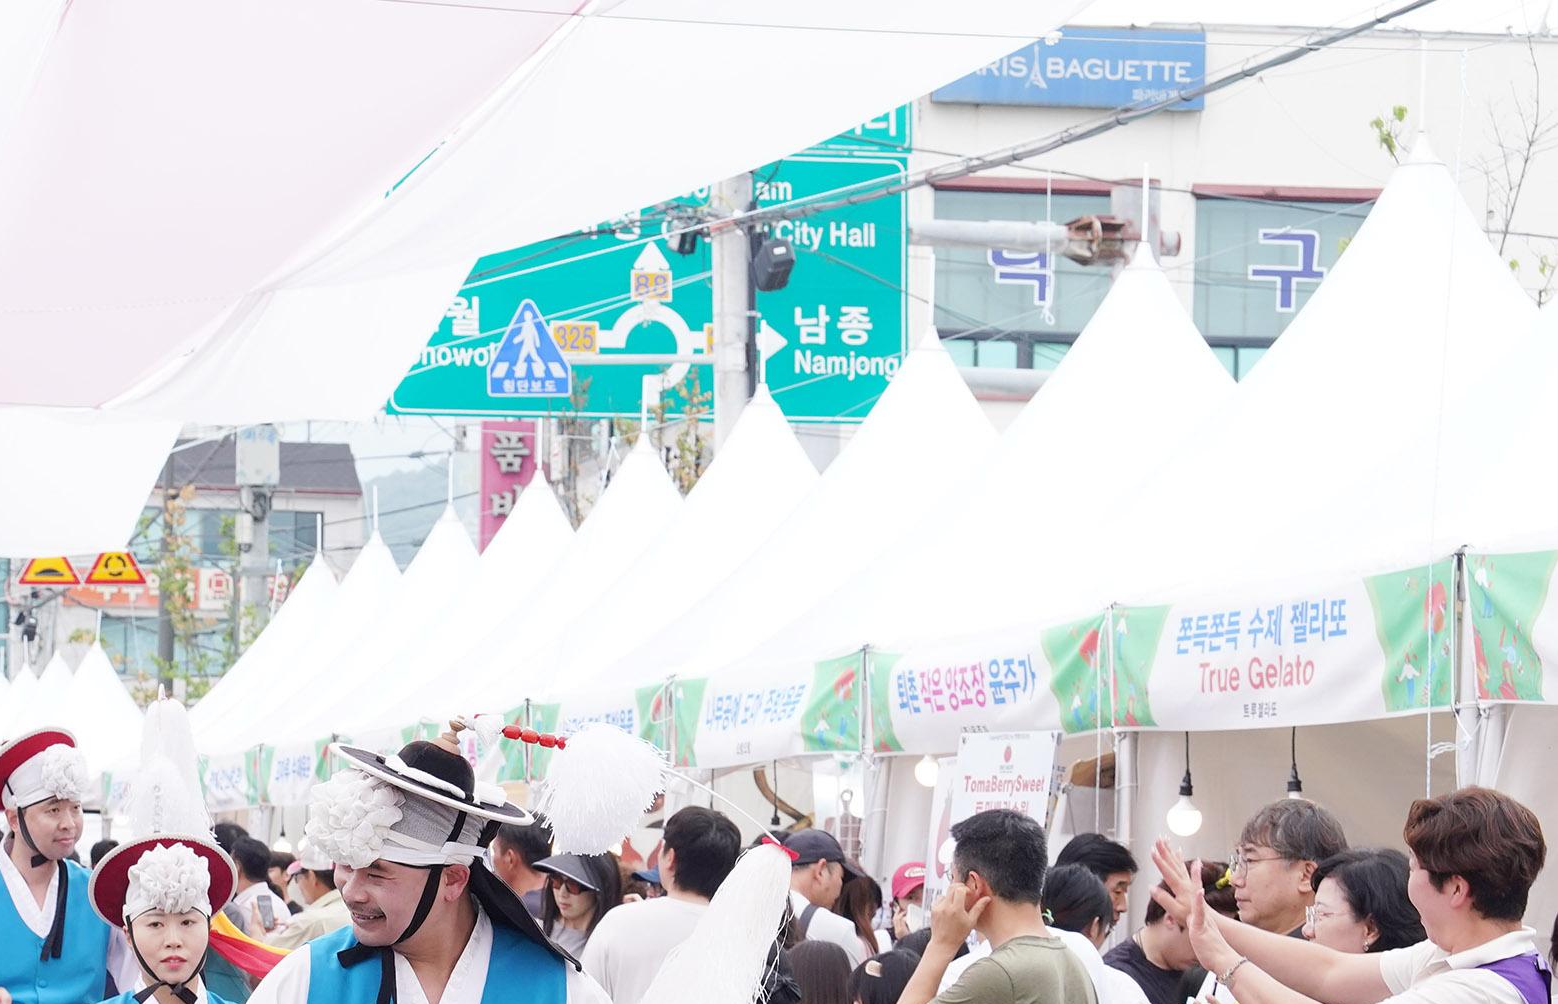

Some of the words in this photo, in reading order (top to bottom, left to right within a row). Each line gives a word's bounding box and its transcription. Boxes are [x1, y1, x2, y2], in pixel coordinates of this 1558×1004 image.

[1046, 57, 1192, 83] BAGUETTE
[775, 219, 824, 252] City
[829, 221, 876, 247] Hall
[635, 274, 668, 297] 88
[556, 326, 594, 352] 325
[794, 304, 873, 346] 남종
[794, 350, 899, 381] Namjong
[1176, 610, 1241, 655] 쫀득쫀득
[1248, 604, 1283, 649] 수제
[1290, 598, 1348, 645] 젤라또
[897, 669, 921, 715] 퇴촌
[919, 667, 945, 713] 작은
[945, 661, 986, 711] 양조장
[987, 653, 1036, 705] 윤주가
[1199, 661, 1240, 694] True
[1248, 654, 1315, 690] Gelato
[964, 774, 1045, 797] TomaBerrySweet
